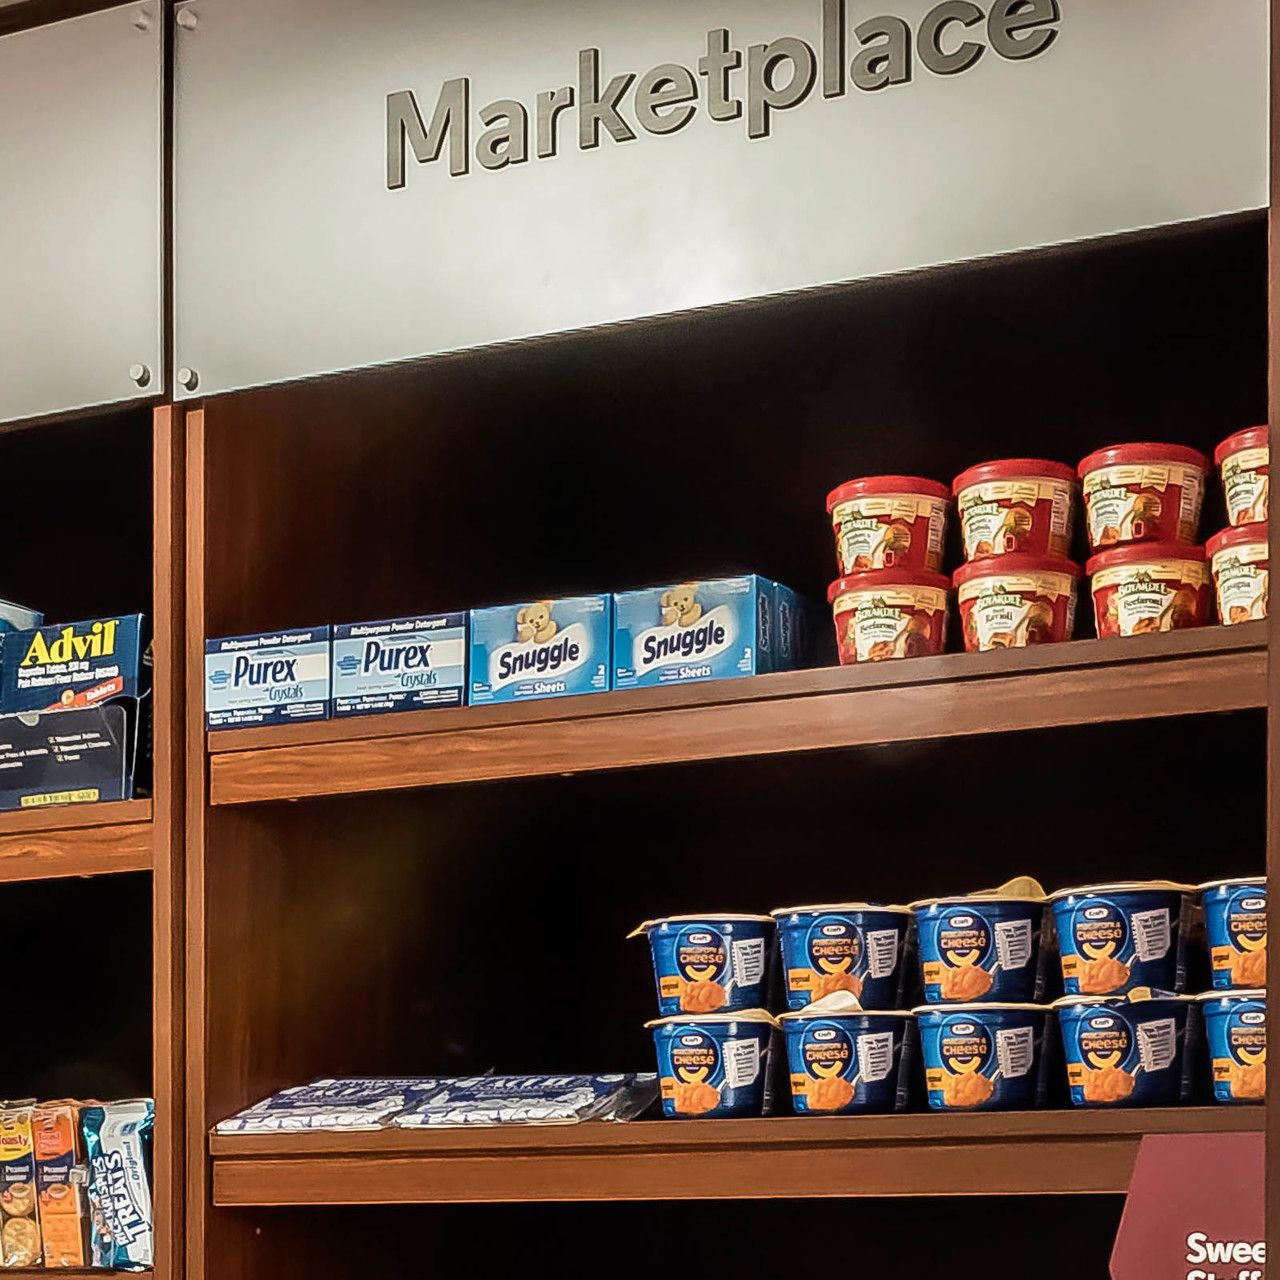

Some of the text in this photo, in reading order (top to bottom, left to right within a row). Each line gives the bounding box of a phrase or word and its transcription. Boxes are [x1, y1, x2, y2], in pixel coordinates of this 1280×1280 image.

[386, 0, 1062, 189] Marketplace
[20, 620, 117, 667] Advil
[363, 641, 431, 673] Purex
[642, 619, 725, 664] Snuggle
[234, 655, 297, 687] Purex
[498, 641, 580, 680] Snuggle
[678, 666, 711, 679] Sheets
[269, 685, 303, 702] Crystals
[400, 671, 437, 688] Crystals
[533, 681, 566, 694] Sheets
[106, 1150, 153, 1243] TREATS
[1185, 1232, 1266, 1264] Swee
